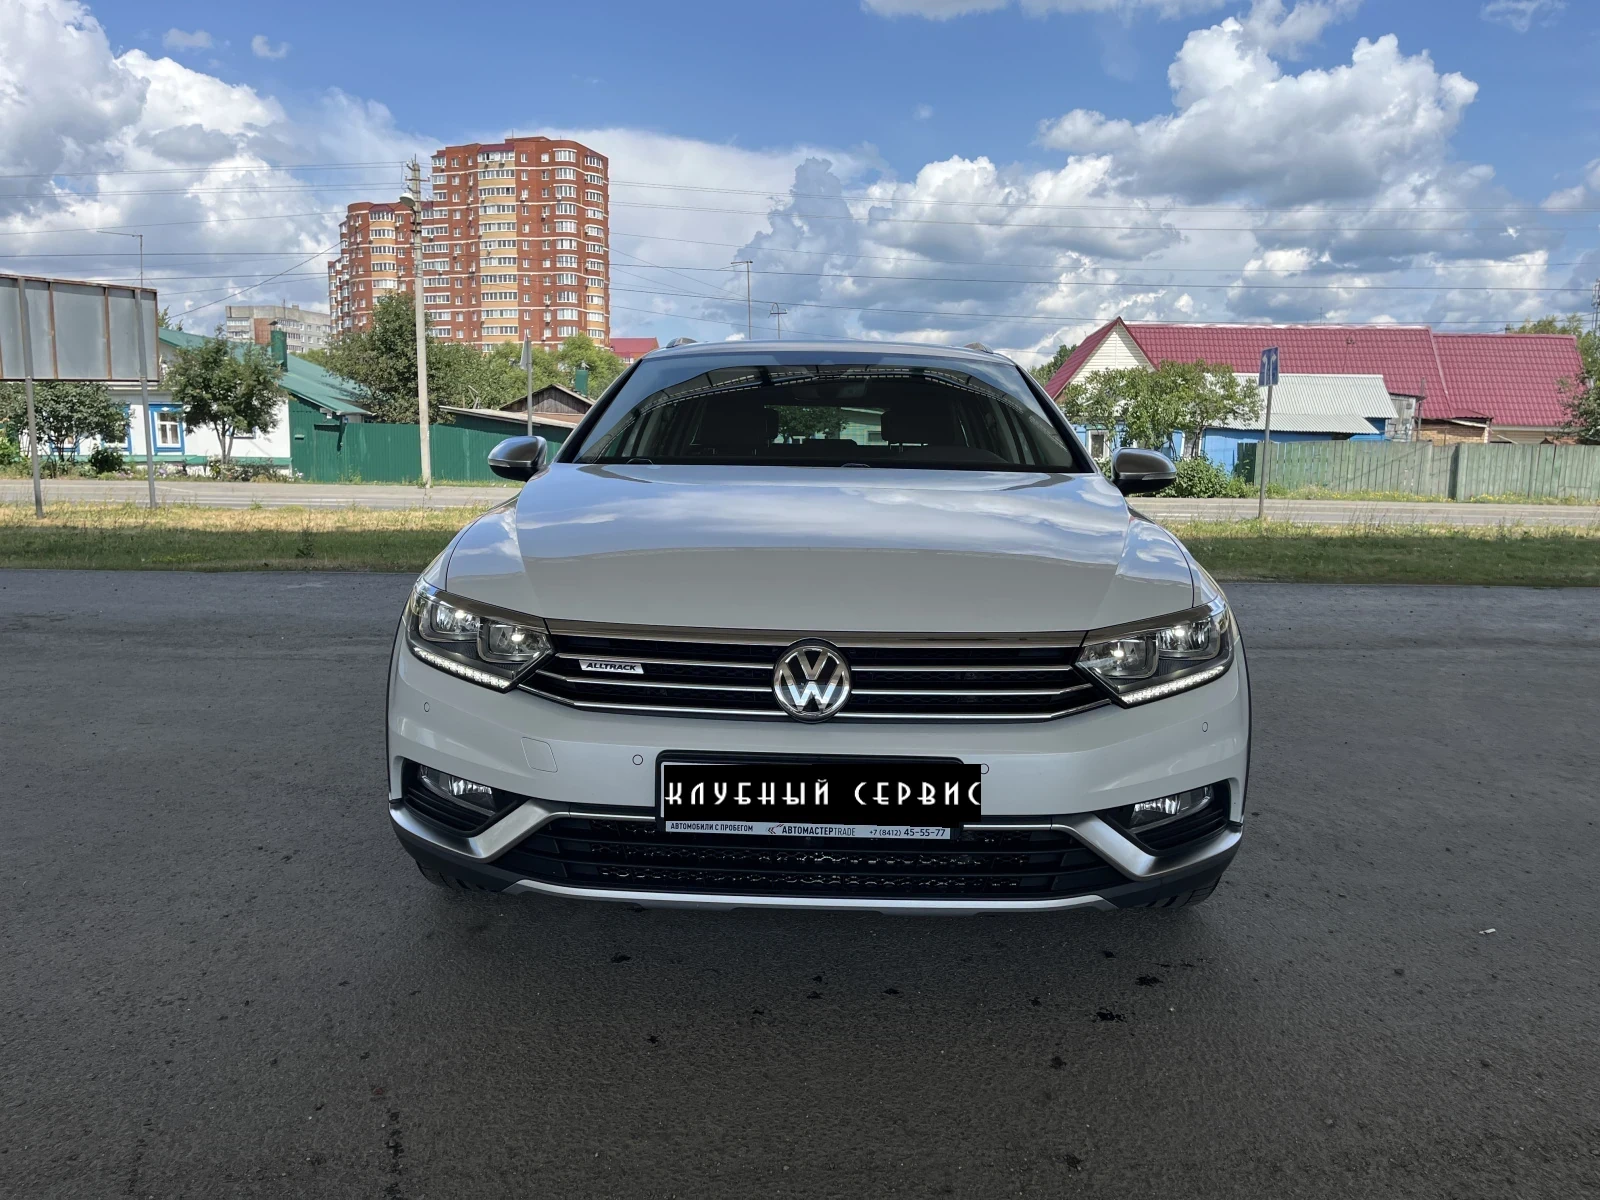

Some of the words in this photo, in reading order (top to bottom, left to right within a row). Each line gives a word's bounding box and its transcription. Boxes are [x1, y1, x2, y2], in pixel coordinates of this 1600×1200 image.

[586, 662, 637, 671] ALLTRACK
[670, 822, 714, 831] АВТОМОБИЛИ
[714, 823, 719, 831] С
[720, 823, 754, 832] ПРОБЕГОМ
[879, 829, 902, 837] (8412)
[903, 828, 946, 837] 45-55-77
